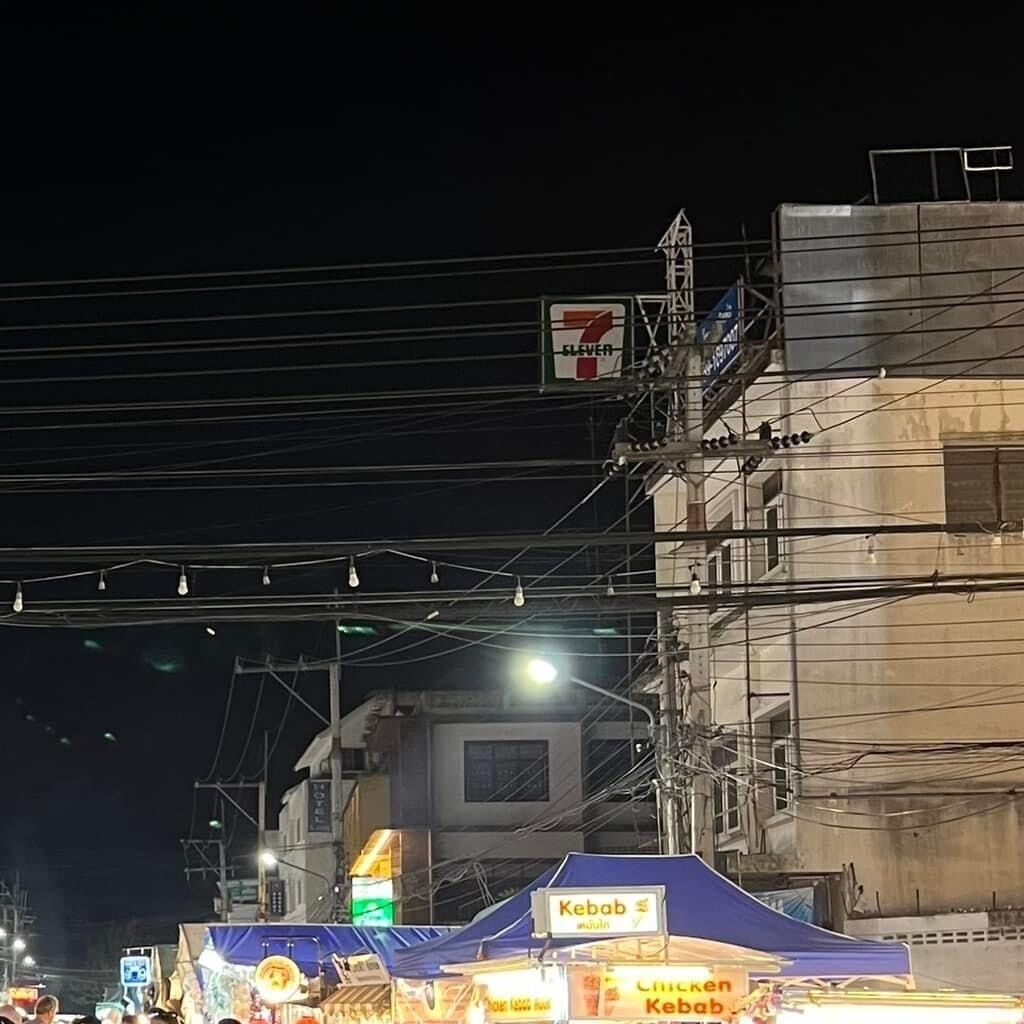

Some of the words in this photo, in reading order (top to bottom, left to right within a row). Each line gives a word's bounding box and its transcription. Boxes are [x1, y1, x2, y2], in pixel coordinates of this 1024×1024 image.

[564, 311, 613, 377] 7
[559, 898, 626, 916] Kebab
[646, 998, 723, 1014] Kebab
